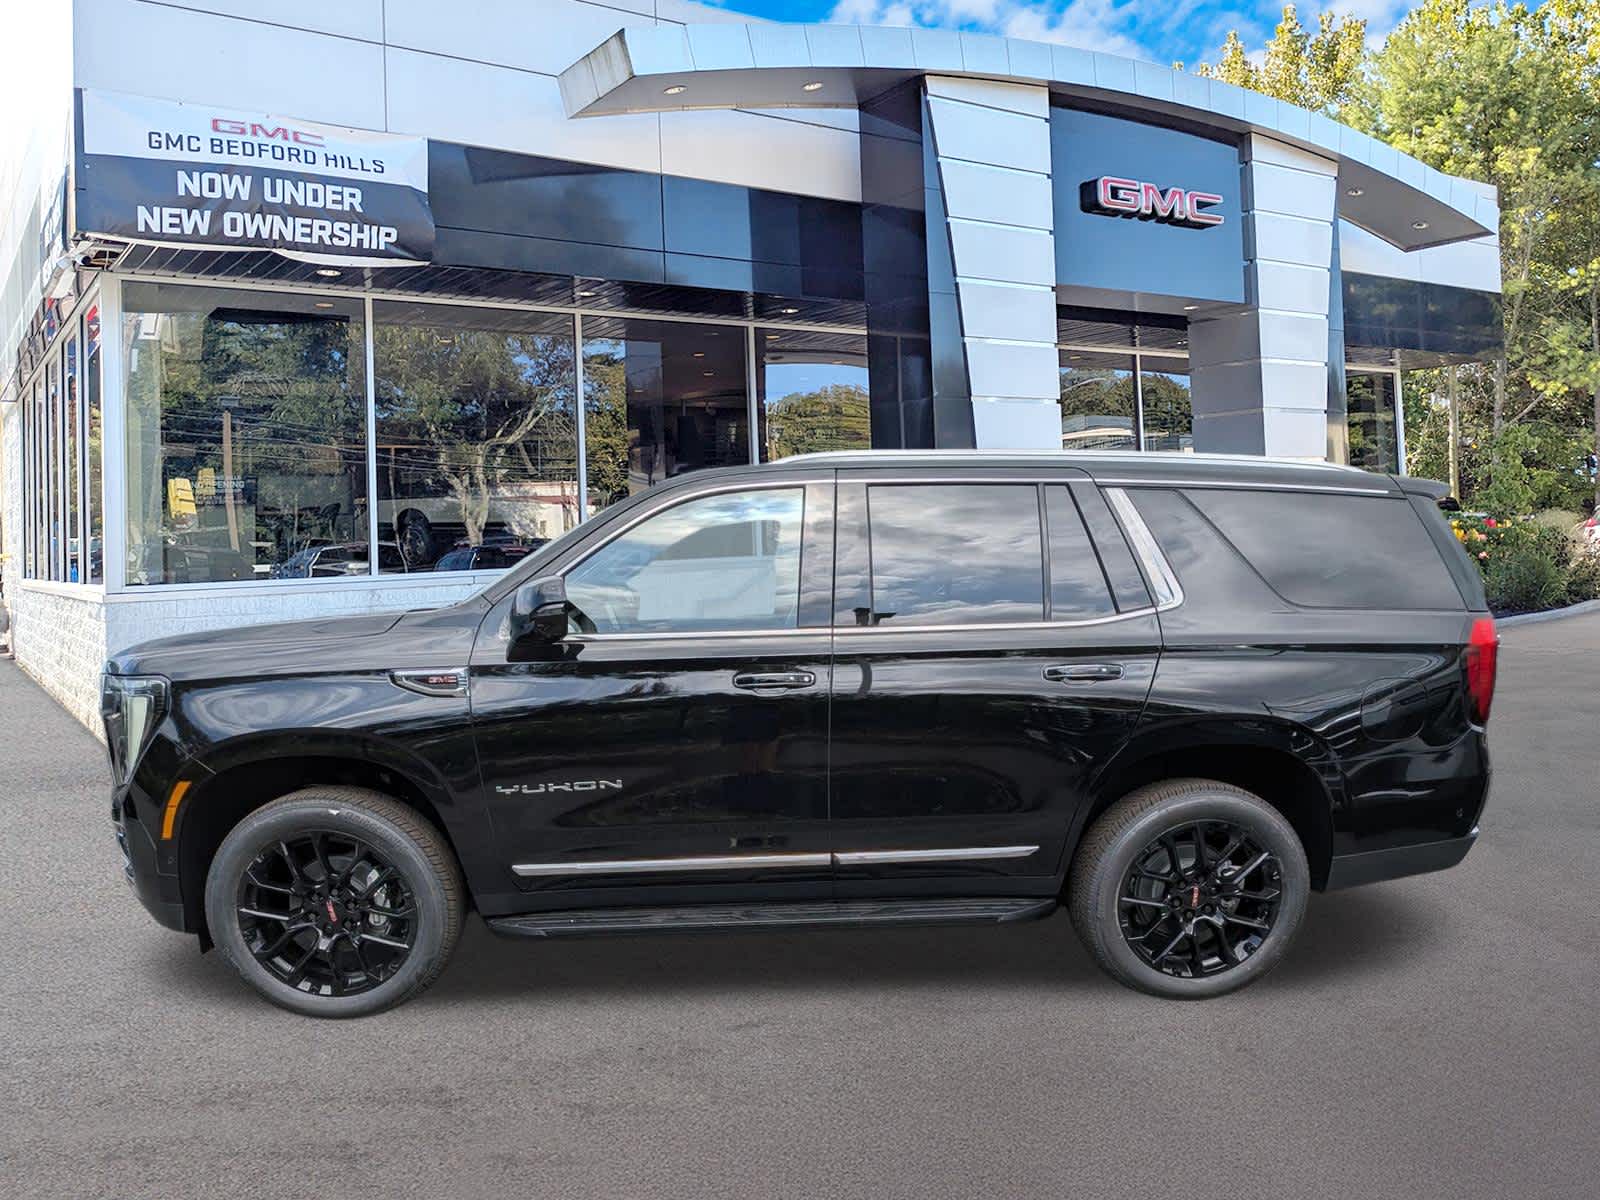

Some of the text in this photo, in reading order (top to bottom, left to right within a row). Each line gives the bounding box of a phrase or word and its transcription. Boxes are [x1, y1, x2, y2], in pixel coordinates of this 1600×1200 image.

[148, 131, 385, 174] GMC BEDFORD HILLS
[211, 118, 326, 148] GMC
[176, 170, 363, 213] NOW UNDER
[1098, 176, 1224, 224] GMC
[136, 205, 398, 250] NEW OWNERSHIP
[495, 779, 623, 799] YUKON
